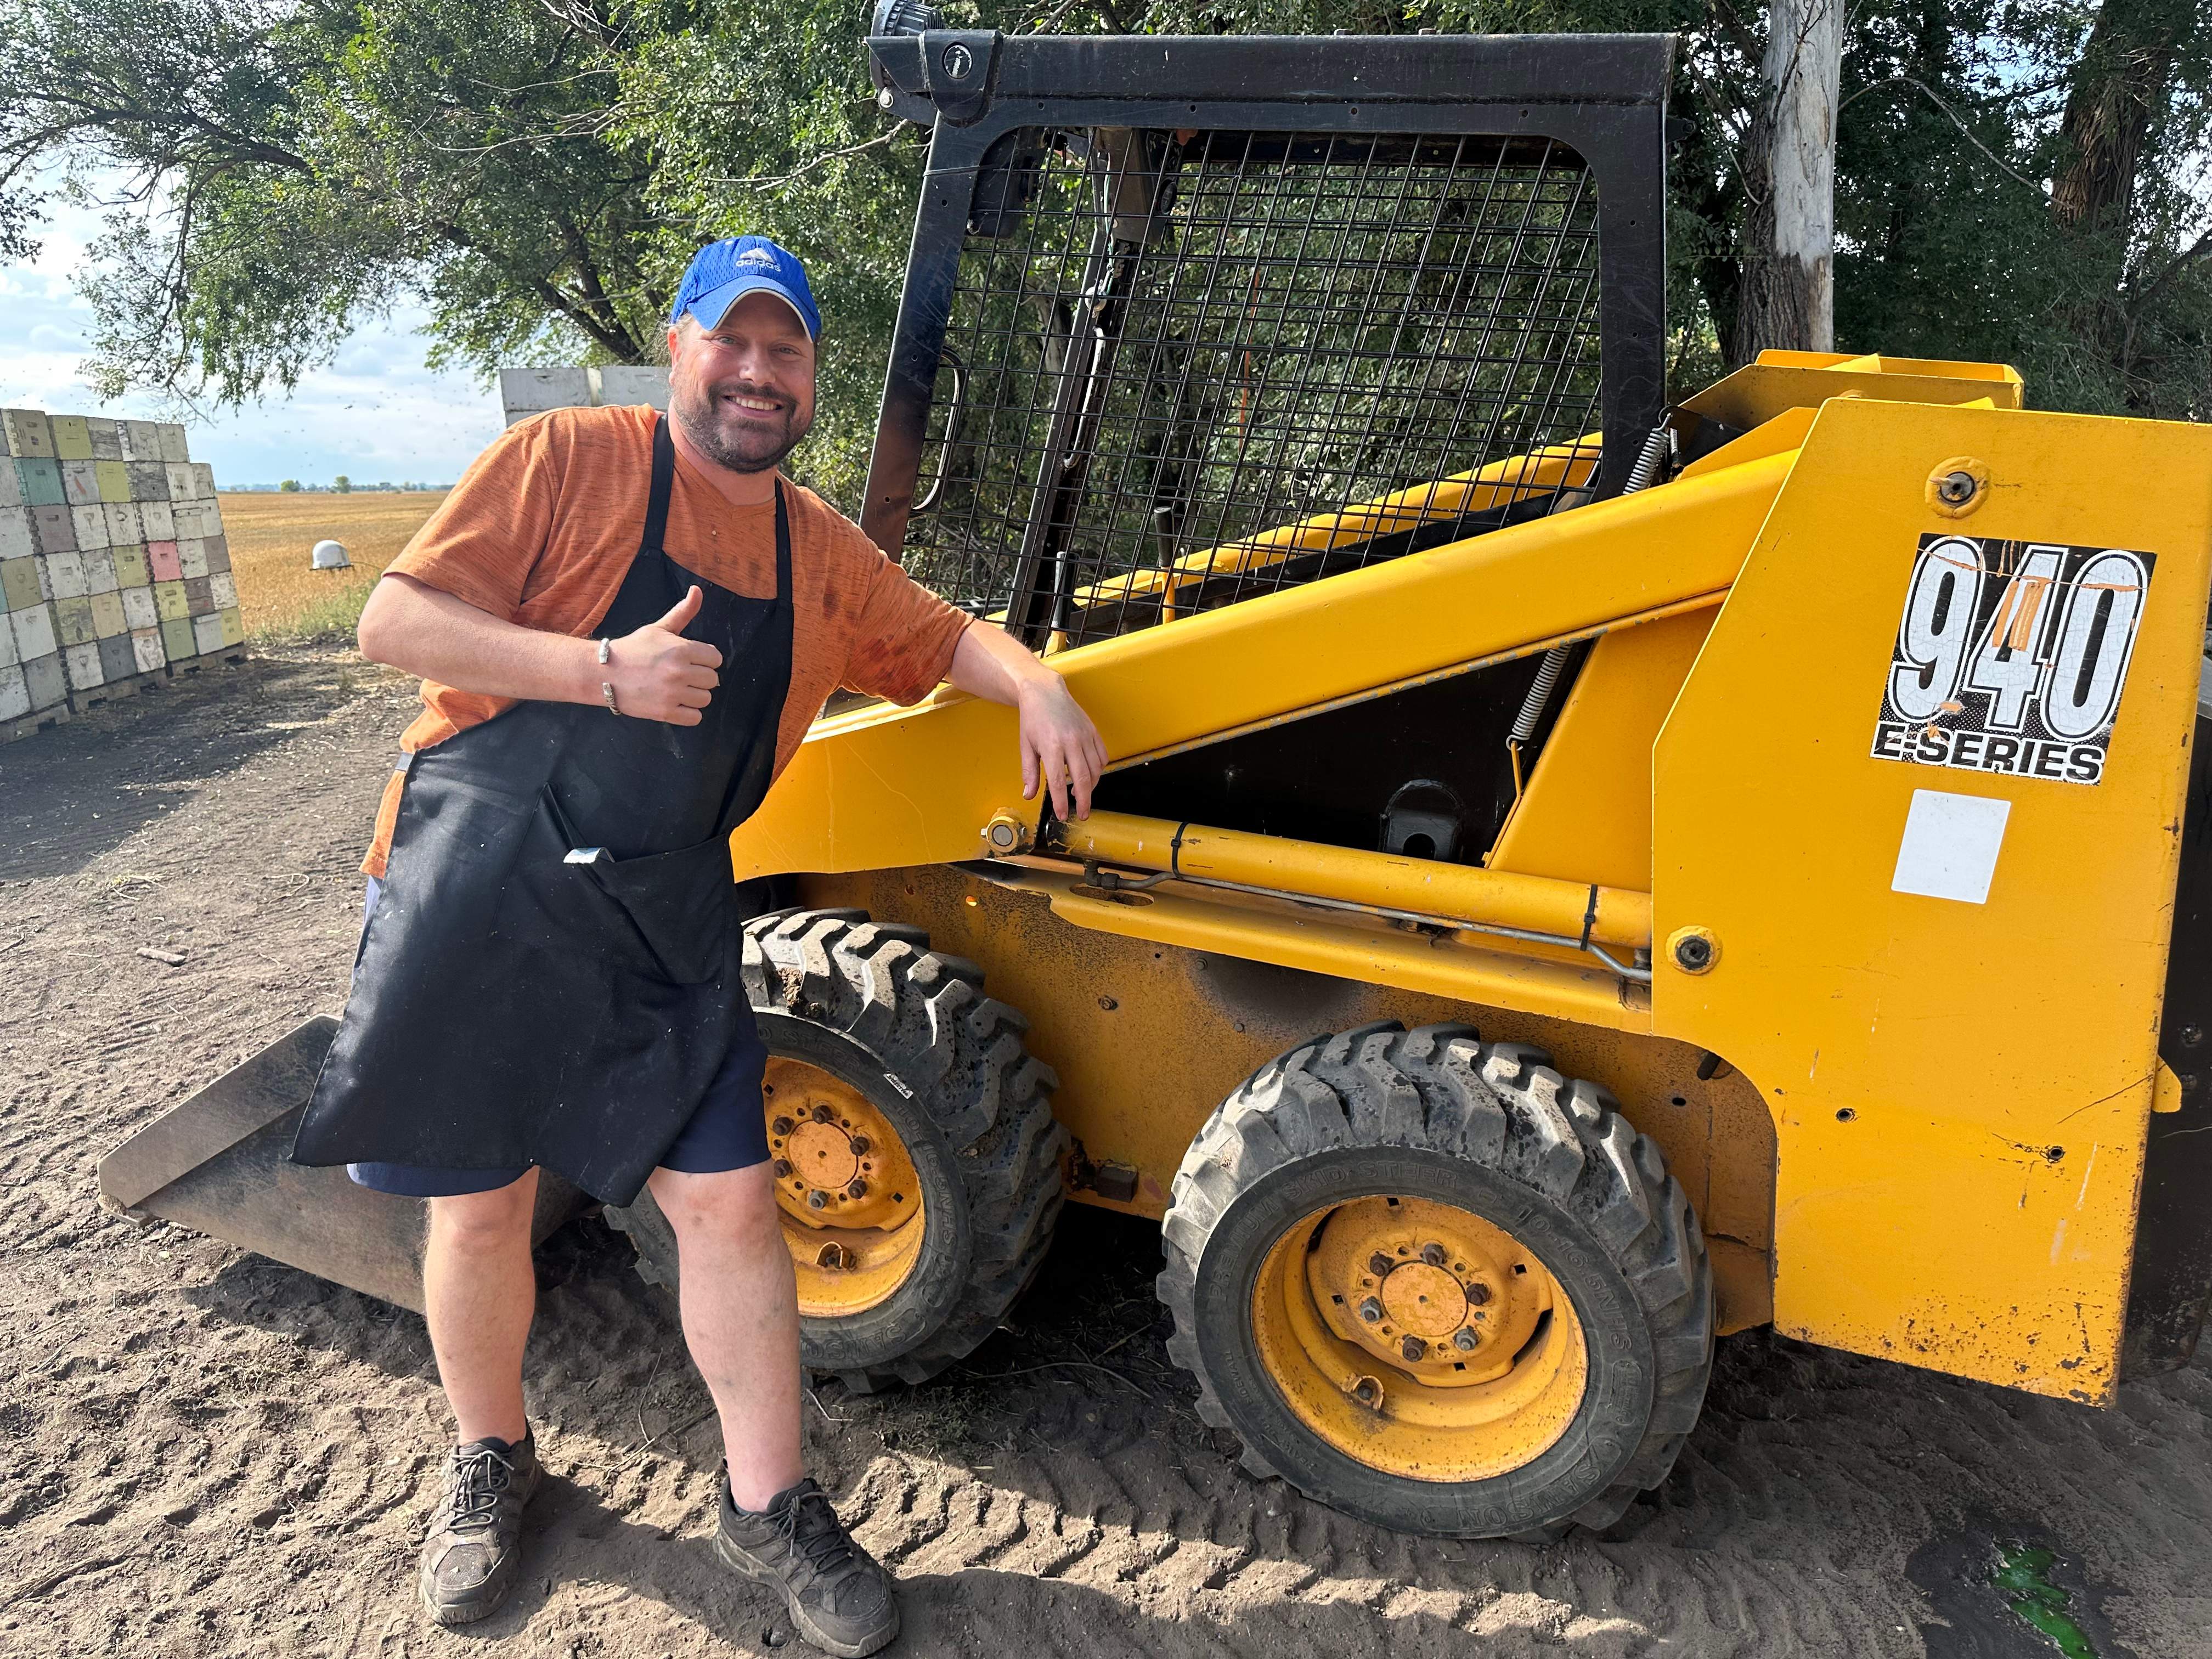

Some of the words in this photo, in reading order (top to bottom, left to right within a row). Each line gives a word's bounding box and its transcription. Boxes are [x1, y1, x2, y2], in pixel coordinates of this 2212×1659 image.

[736, 257, 781, 272] adidas
[1888, 535, 2149, 742] 940
[1872, 722, 2107, 785] E-SERIES
[1207, 1194, 1280, 1303] PREMIUM
[1280, 1165, 1347, 1199] SKID
[1356, 1160, 1458, 1188] STEER
[800, 1323, 903, 1360] SAMSO
[1224, 1349, 1254, 1406] SIDEWALL
[1456, 1463, 1601, 1531] SAMSON
